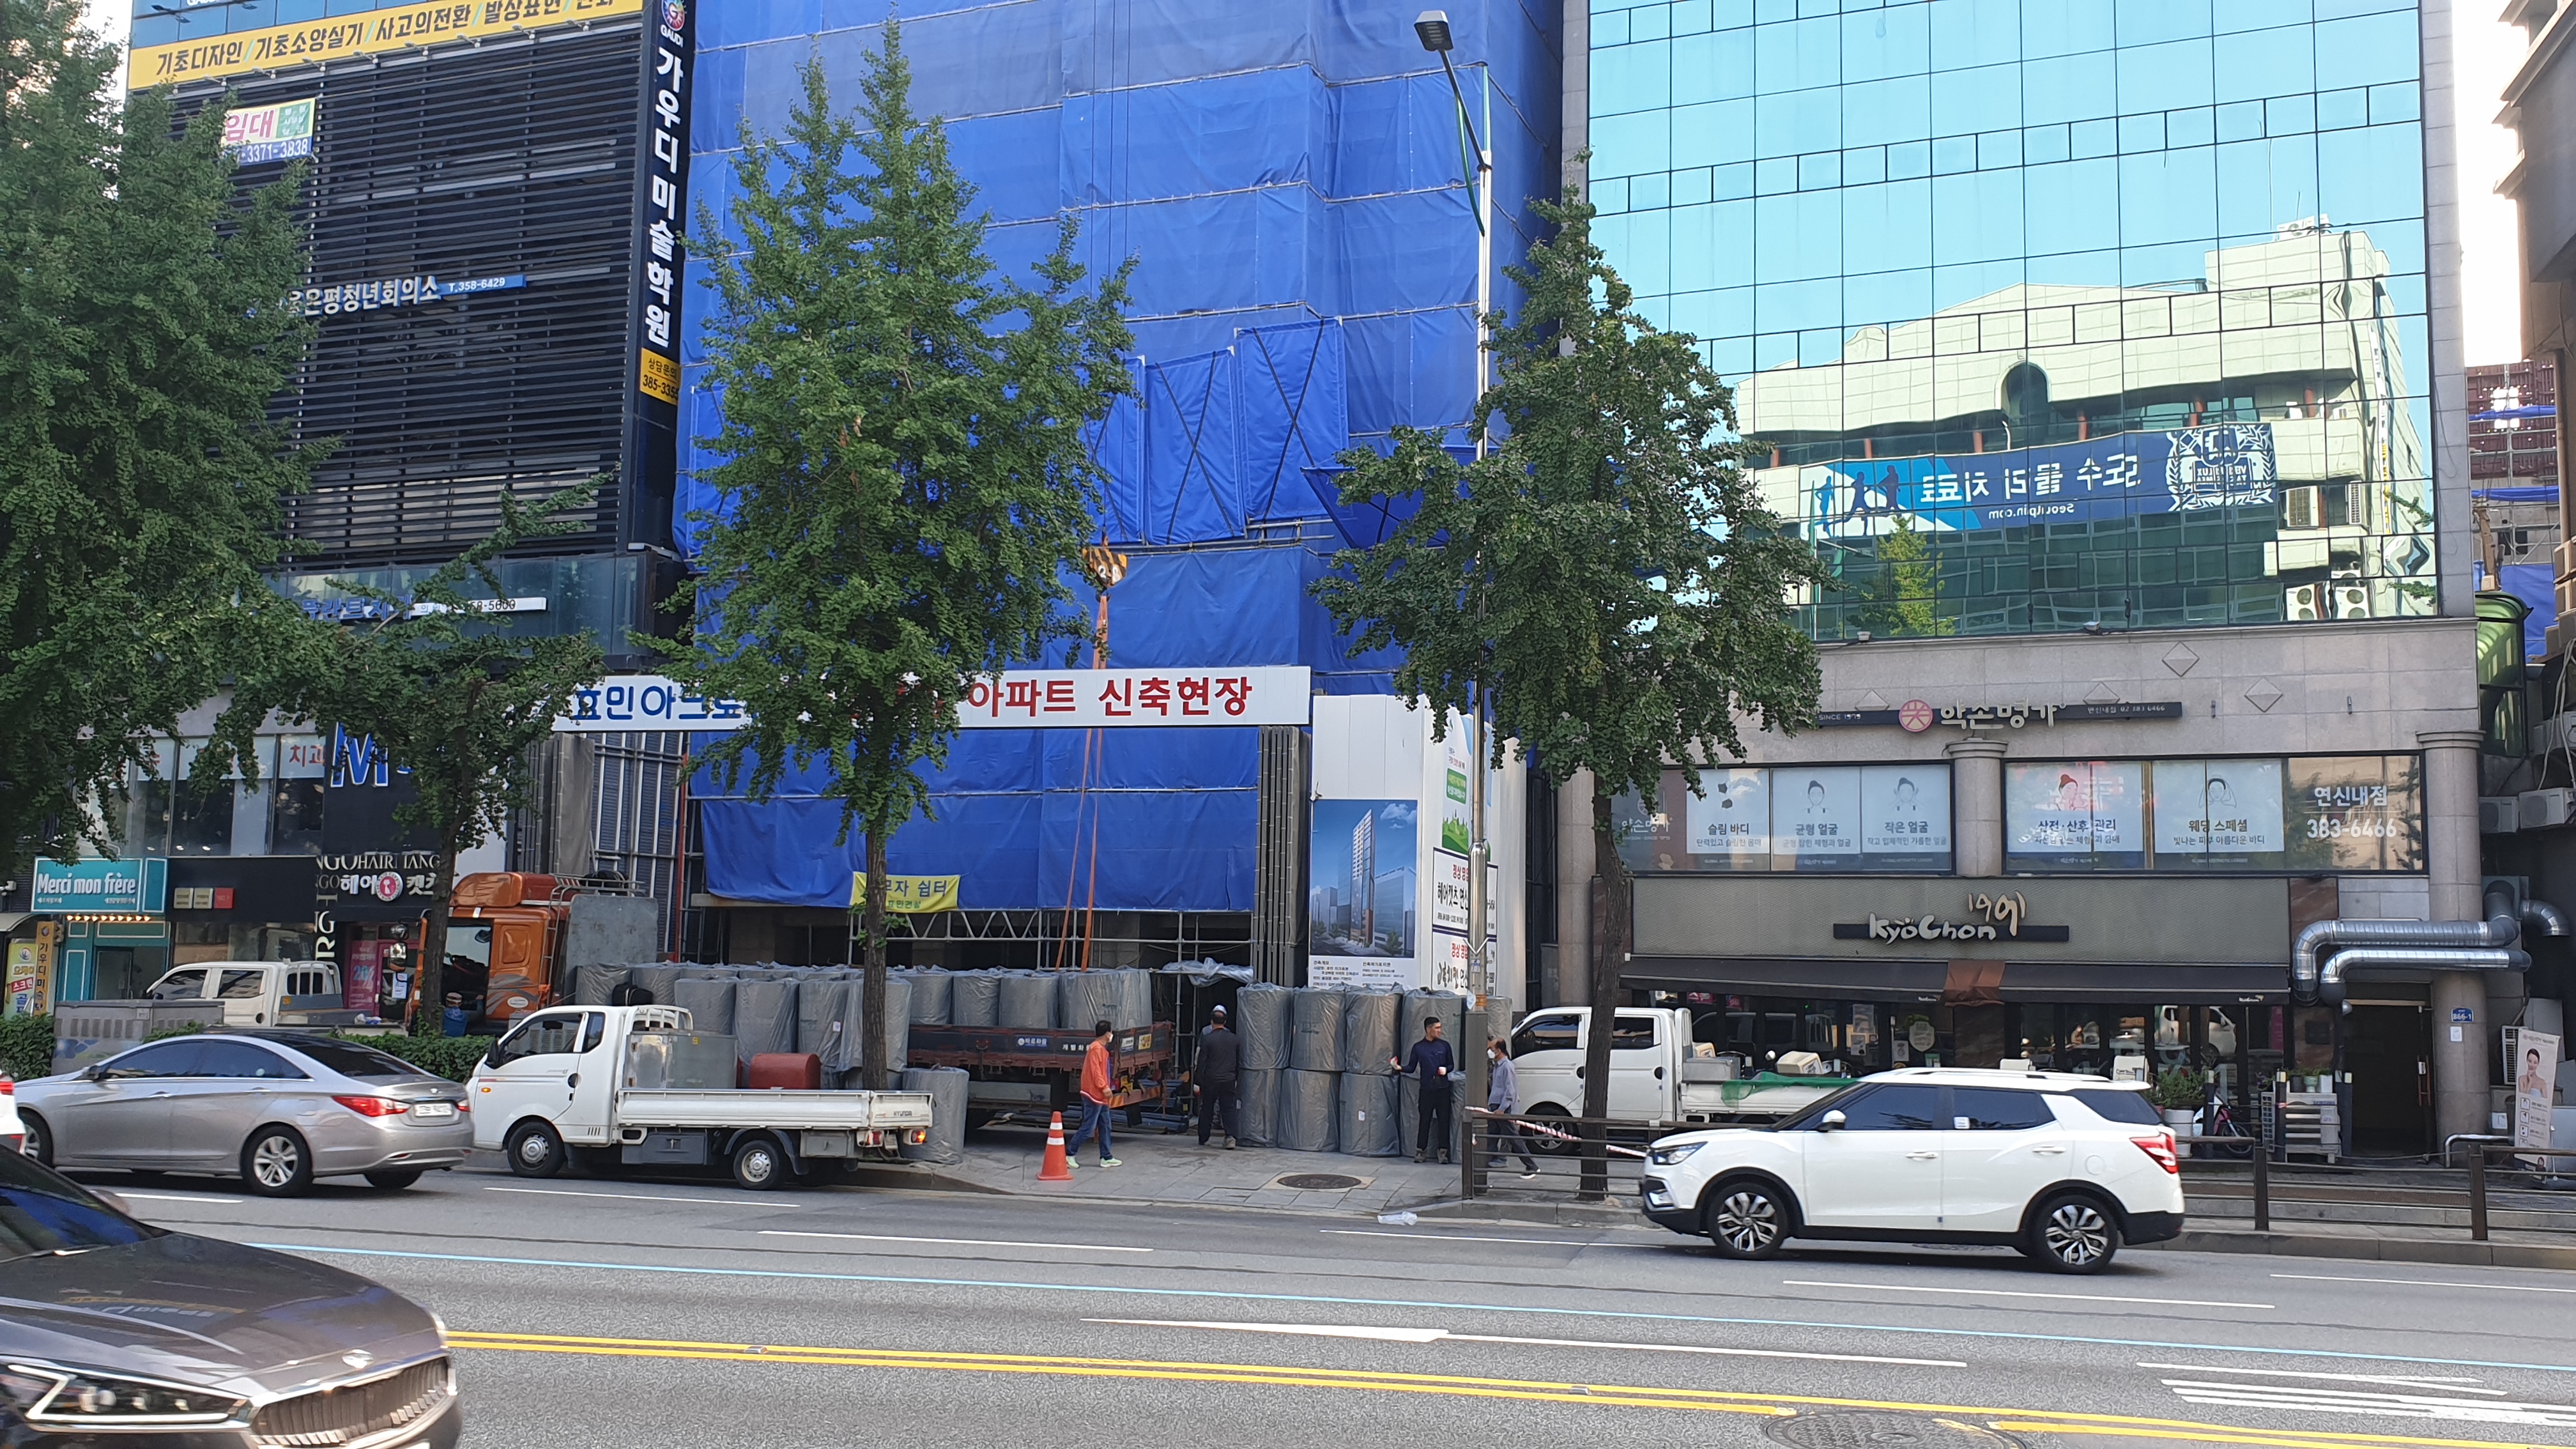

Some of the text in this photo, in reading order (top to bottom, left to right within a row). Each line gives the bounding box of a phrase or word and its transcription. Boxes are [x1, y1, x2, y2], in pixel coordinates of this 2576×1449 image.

[661, 24, 683, 47] GAUDI
[227, 110, 275, 142] 임대
[968, 678, 1076, 717] 아파트
[1098, 676, 1253, 717] 신축현장
[1940, 696, 2058, 730] 약손명가
[2314, 785, 2388, 807] 연신내점
[1708, 823, 1749, 836] 슬림 바디
[1818, 823, 1839, 836] 얼굴
[1885, 820, 1929, 834] 작은 얼굴
[2214, 818, 2248, 832] 스페셜
[2307, 817, 2396, 838] 383-6466
[2249, 834, 2265, 844] 바디
[37, 872, 135, 894] Merci mon frère
[341, 874, 377, 895] 헤어
